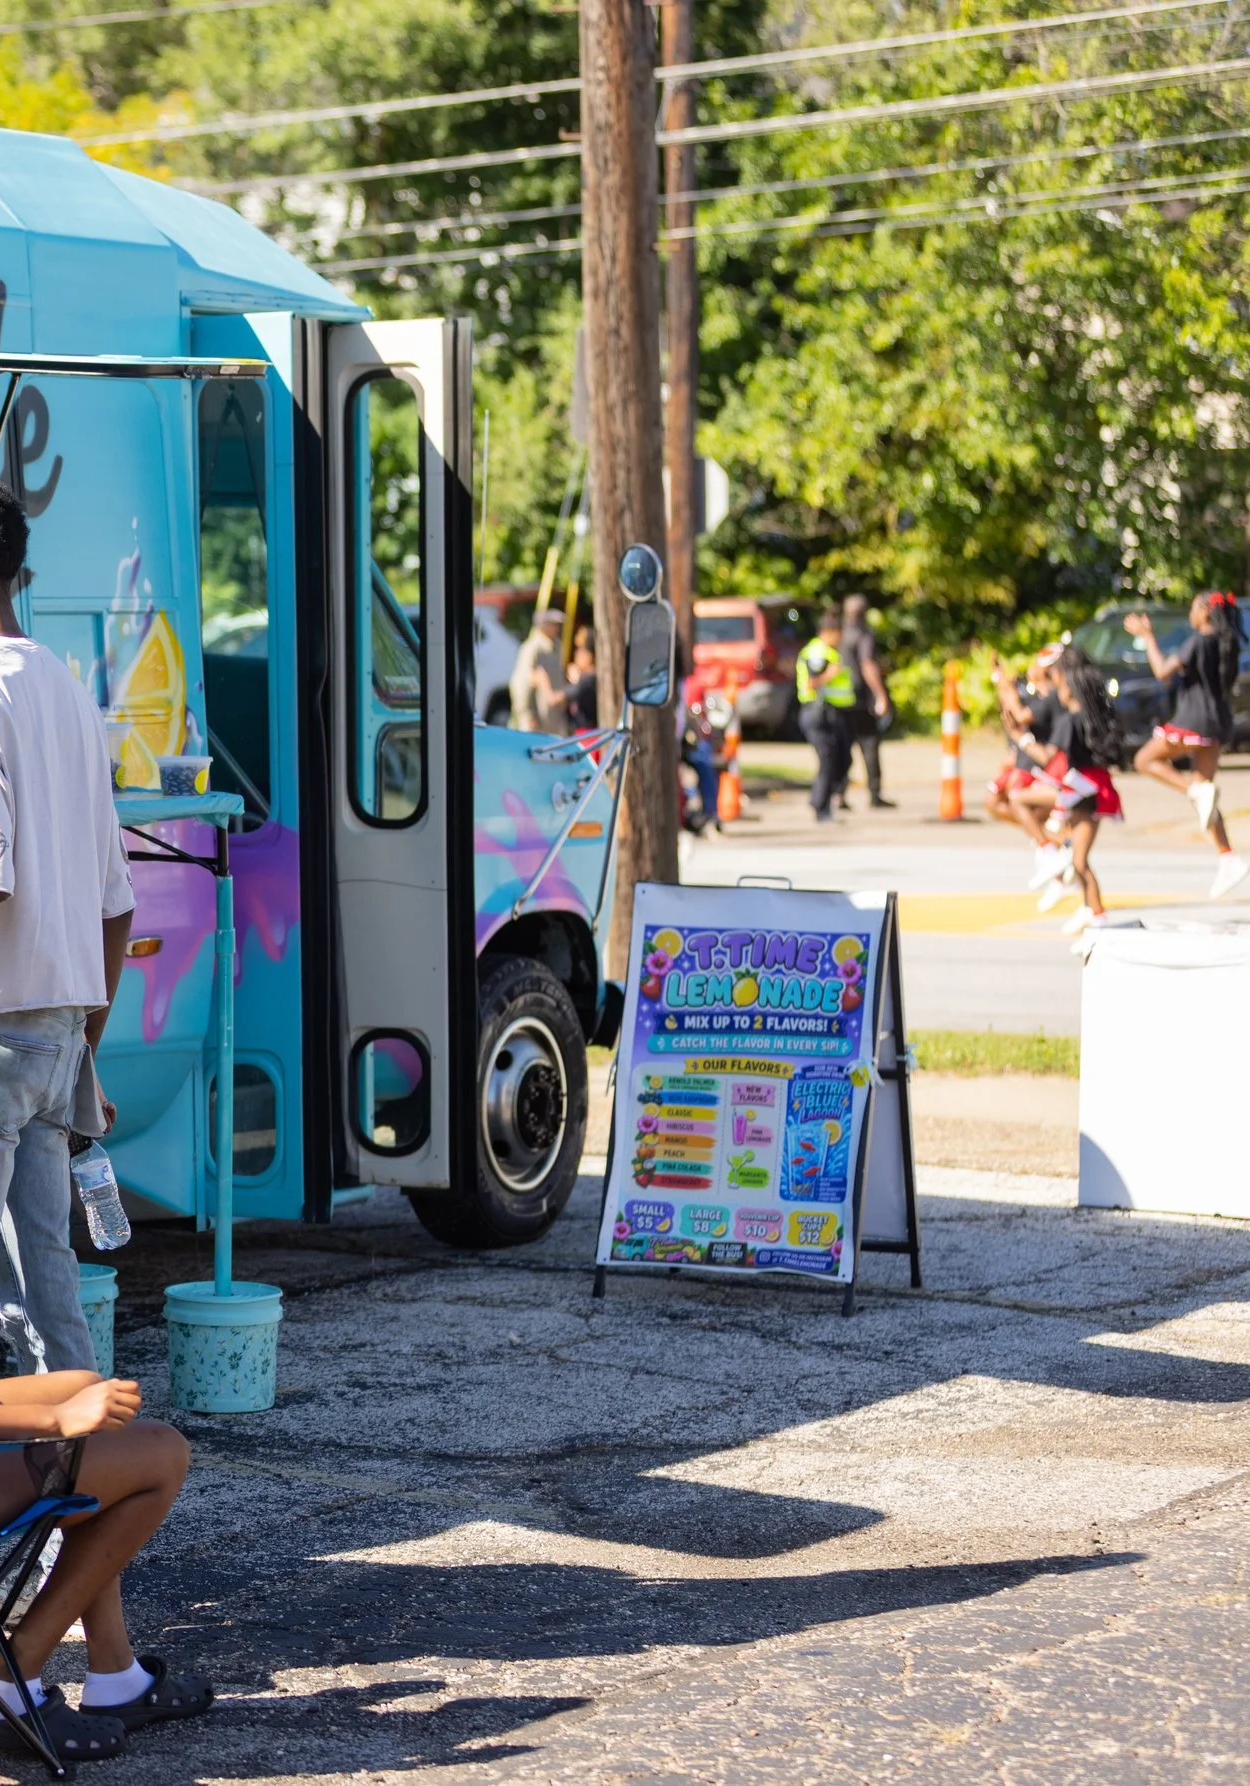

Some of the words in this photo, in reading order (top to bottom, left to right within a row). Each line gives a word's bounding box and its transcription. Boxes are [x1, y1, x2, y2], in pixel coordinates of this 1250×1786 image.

[666, 971, 843, 1013] LEMONADE
[684, 1015, 709, 1029] MIX
[713, 1016, 730, 1029] UP
[734, 1015, 749, 1029] TO
[753, 1015, 763, 1030] 2
[766, 1018, 828, 1032] FLAVORS!
[672, 1035, 706, 1048] CATCH
[710, 1036, 728, 1048] THE
[732, 1037, 770, 1049] FLAVOR
[787, 1039, 817, 1050] EVERY
[821, 1040, 838, 1051] SIP!
[703, 1060, 727, 1070] OUR
[731, 1060, 780, 1074] FLAVORS
[793, 1082, 849, 1098] ELECTRIC
[739, 1094, 767, 1102] FLAVORS
[806, 1095, 837, 1108] BLUE
[666, 1123, 694, 1131] HIBISCUS
[665, 1136, 687, 1144] MANGO
[632, 1203, 665, 1216] SMALL
[690, 1208, 722, 1220] LARGE
[637, 1216, 653, 1229] $5
[693, 1220, 709, 1232] $8
[797, 1215, 829, 1224] BUCKET
[744, 1224, 767, 1237] $10
[802, 1223, 822, 1231] CUPS
[799, 1231, 819, 1244] $12
